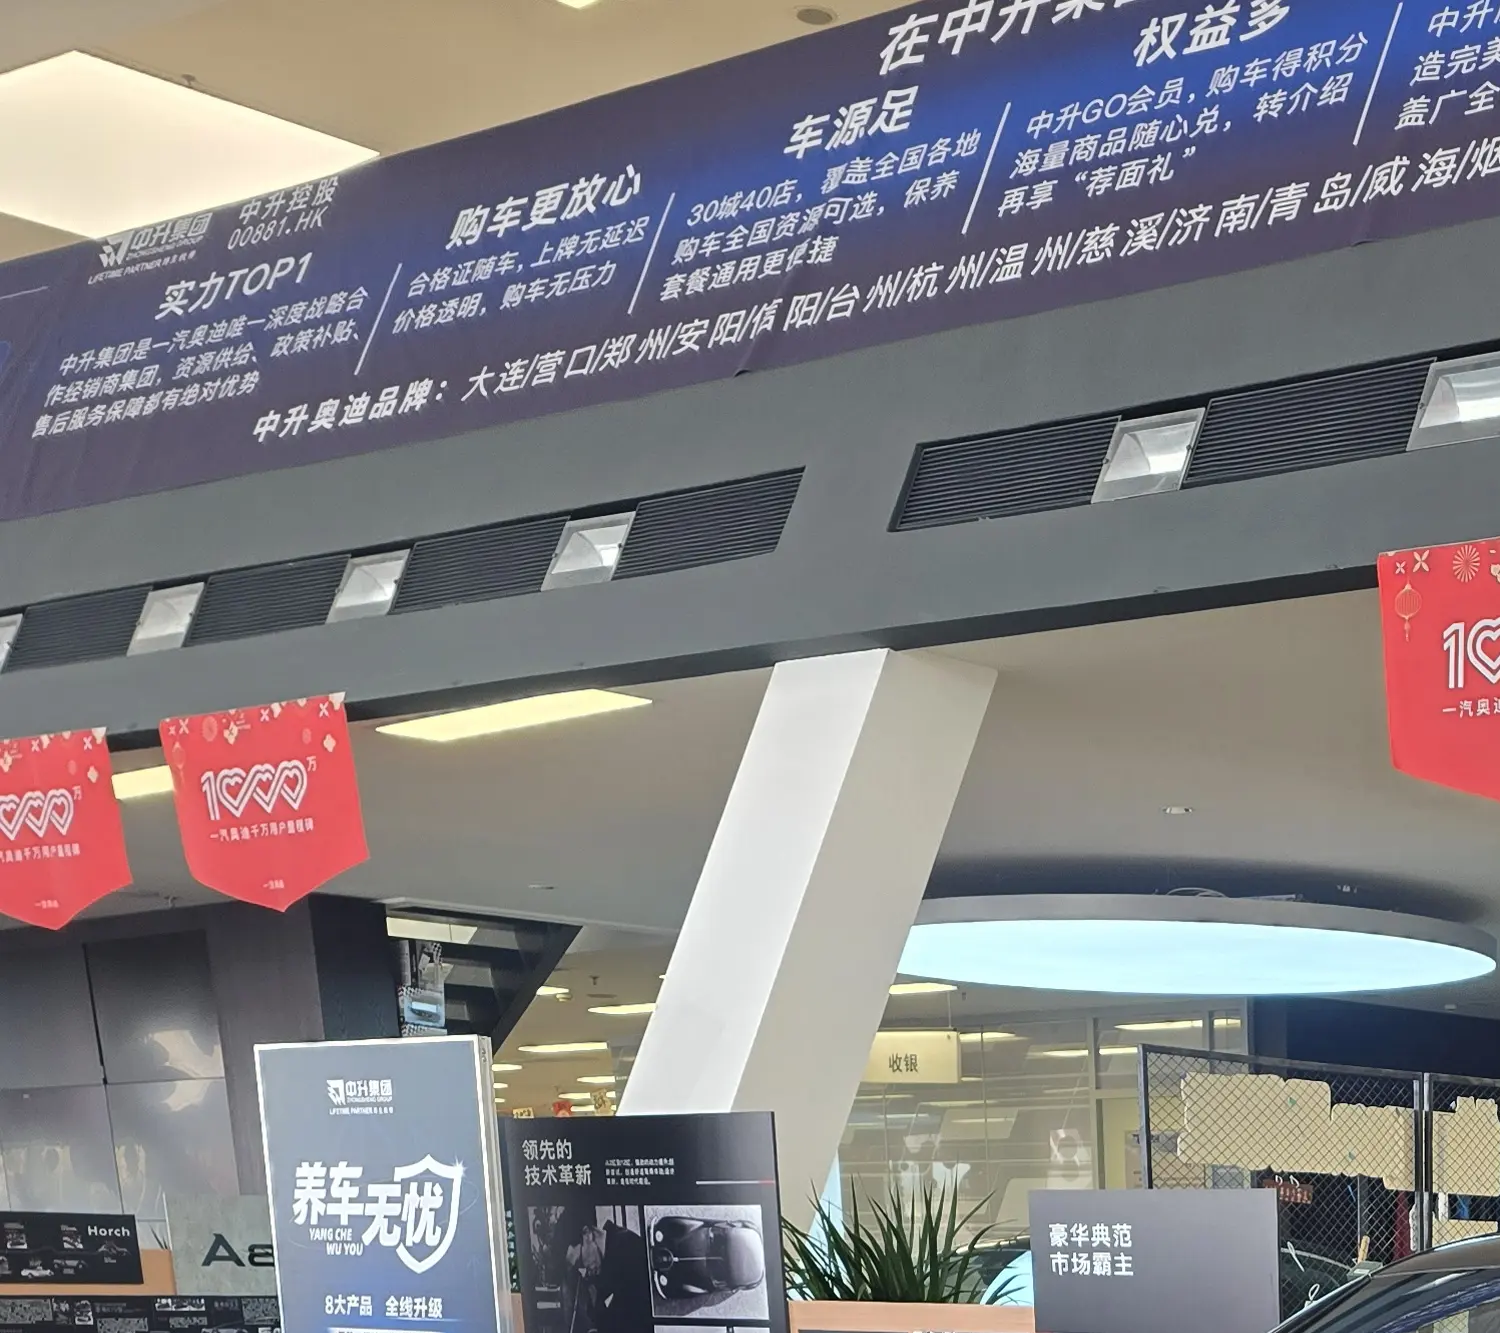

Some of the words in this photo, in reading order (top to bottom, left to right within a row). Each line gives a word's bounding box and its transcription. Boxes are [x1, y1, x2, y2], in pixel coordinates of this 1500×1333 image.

[1133, 0, 1291, 67] 权益多
[1026, 31, 1369, 141] 中升GO会员，购车得积分
[783, 85, 919, 160] 车源足
[1009, 72, 1354, 181] 海量商品随心兑，转介绍
[238, 176, 339, 225] 中升控股
[445, 164, 642, 251] 购车更放心
[686, 127, 982, 227] 30城40店，覆盖全国各地
[227, 206, 329, 251] 00881.HK
[671, 170, 961, 265] 购车全国资源可选，保养
[155, 252, 313, 321] 实力TOP1
[406, 215, 650, 298] 合格证随车，上牌无延迟
[659, 235, 839, 301] 套餐通用更便捷
[59, 286, 369, 377] 中升集团是一汽奥迪唯一深度战略合
[392, 261, 617, 335] 价格透明，购车无压力
[31, 371, 261, 439] 售后服务保障都有绝对优势
[888, 1052, 919, 1074] 收银
[522, 1138, 572, 1160] 领先的
[524, 1163, 592, 1186] 技术革新
[87, 1225, 131, 1237] Horch
[293, 1160, 443, 1248] 养车无忧
[309, 1228, 333, 1241] YANG
[335, 1228, 352, 1241] CHE
[1048, 1223, 1133, 1248] 豪华典范
[326, 1242, 341, 1255] WU
[342, 1242, 364, 1256] YOU
[1050, 1252, 1134, 1277] 市场霸主
[324, 1294, 373, 1317] 8大产品
[385, 1296, 443, 1319] 全线升级
